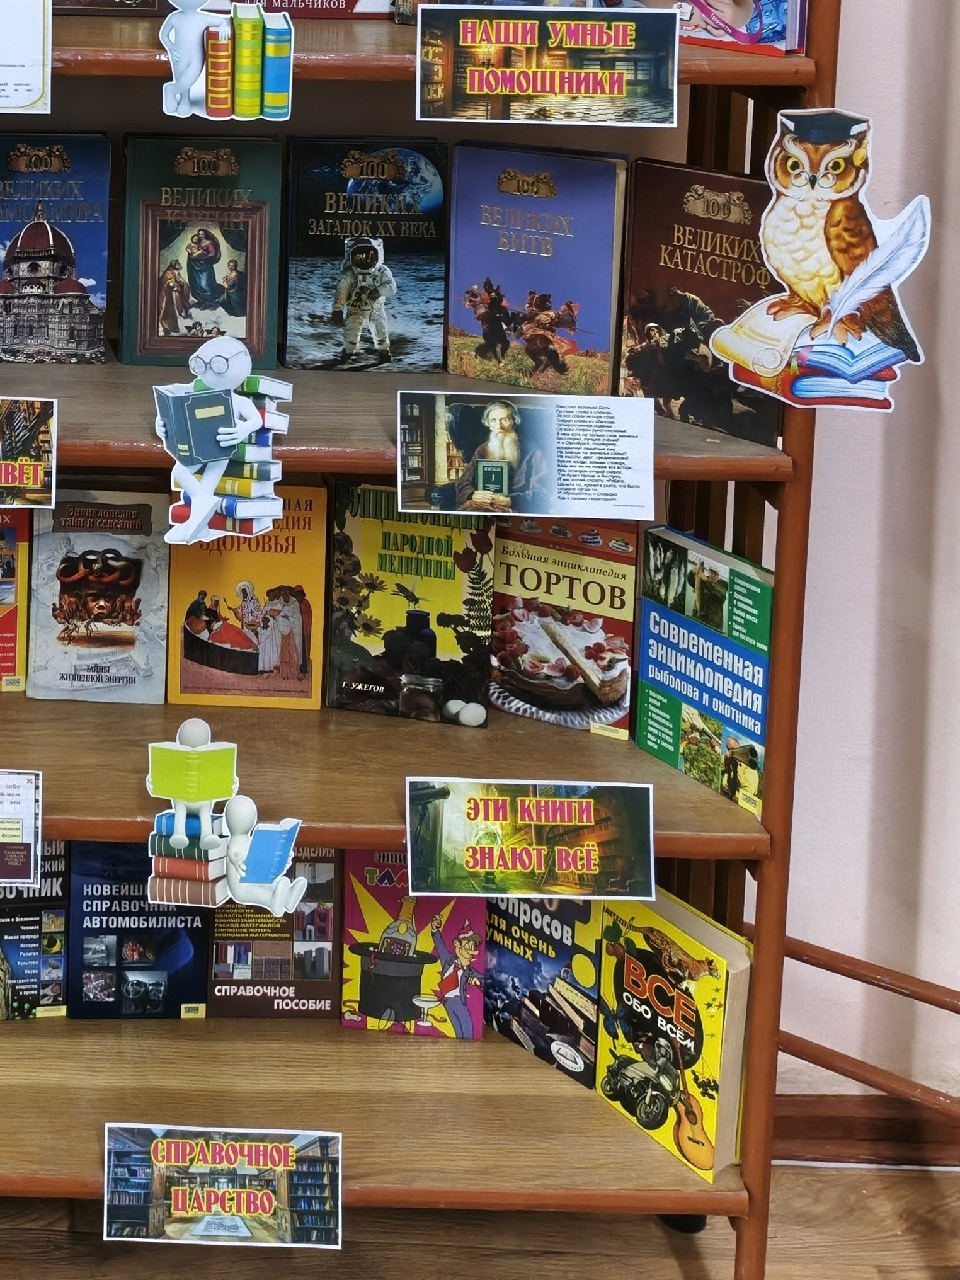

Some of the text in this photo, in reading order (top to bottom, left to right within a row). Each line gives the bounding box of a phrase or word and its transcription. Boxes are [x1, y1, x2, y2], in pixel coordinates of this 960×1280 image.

[460, 19, 636, 49] НАШИ УМНЫЕ
[466, 69, 626, 98] ПОМОЩНИКИ
[359, 161, 388, 180] 100
[160, 187, 253, 207] ВЕЛИКИХ
[324, 192, 423, 215] ВЕЛИКИХ
[701, 197, 732, 218] 100
[308, 218, 438, 238] ЗАГАДОК ВЕКА
[480, 204, 575, 238] ВЕЛИКИХ
[497, 230, 554, 257] БИТВ
[672, 223, 762, 263] ВЕЛИКИХ
[659, 245, 772, 290] КАТАСТРОФ
[381, 531, 453, 558] НАРОДНОЙ
[377, 552, 456, 581] МЕДИЦИНЫ
[500, 546, 549, 565] Большая
[551, 555, 628, 581] энциклопедия
[499, 561, 627, 612] ТОРТОВ
[648, 610, 764, 689] Современная
[350, 681, 385, 694] УЖЕГОВ
[648, 638, 763, 715] энциклопедия
[647, 664, 700, 702] рыболова
[711, 699, 762, 736] охотника
[466, 797, 594, 825] ЭТИ КНИГИ
[464, 842, 598, 873] ЗНАЮТ ВСЁ
[82, 916, 203, 929] АВТОМОБИЛИСТА
[511, 925, 557, 958] очень
[214, 985, 295, 998] СПРАВОЧНОЕ
[274, 998, 332, 1011] ПОСОБИЕ
[623, 953, 697, 1037] ВСЕ
[622, 991, 696, 1053] ОБО ВСЁМ
[151, 1139, 296, 1169] СПРАВОЧНОЕ
[171, 1187, 275, 1216] ЦАРСТВО
